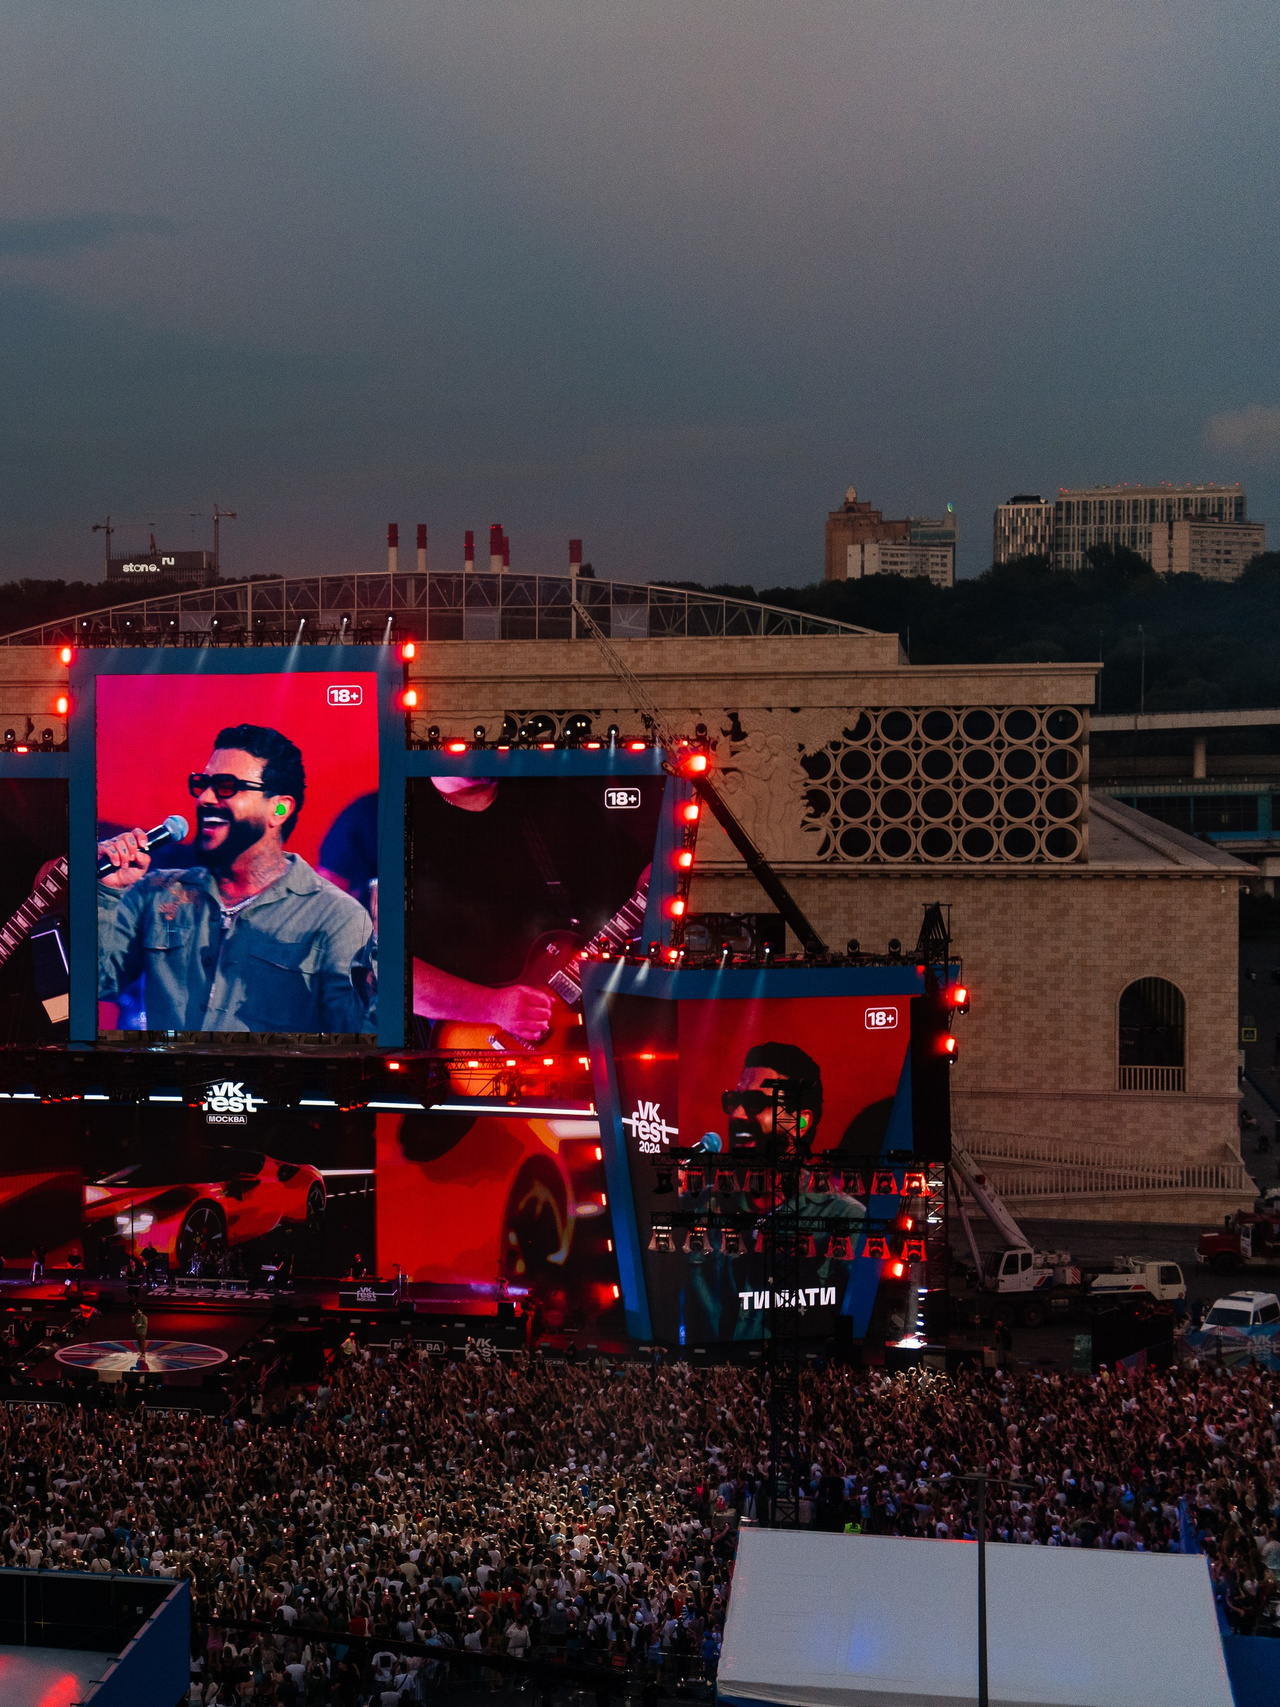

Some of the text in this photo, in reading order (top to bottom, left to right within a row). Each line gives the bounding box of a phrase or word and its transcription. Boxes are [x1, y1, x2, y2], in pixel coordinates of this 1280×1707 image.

[122, 557, 175, 573] stone. ru
[329, 688, 360, 703] 18+
[607, 791, 638, 806] 18+
[867, 1010, 895, 1027] 18+
[212, 1081, 245, 1098] VK
[637, 1099, 661, 1123] VK
[207, 1115, 246, 1124] МОСКВА
[631, 1111, 670, 1145] fest
[638, 1140, 661, 1154] 2024
